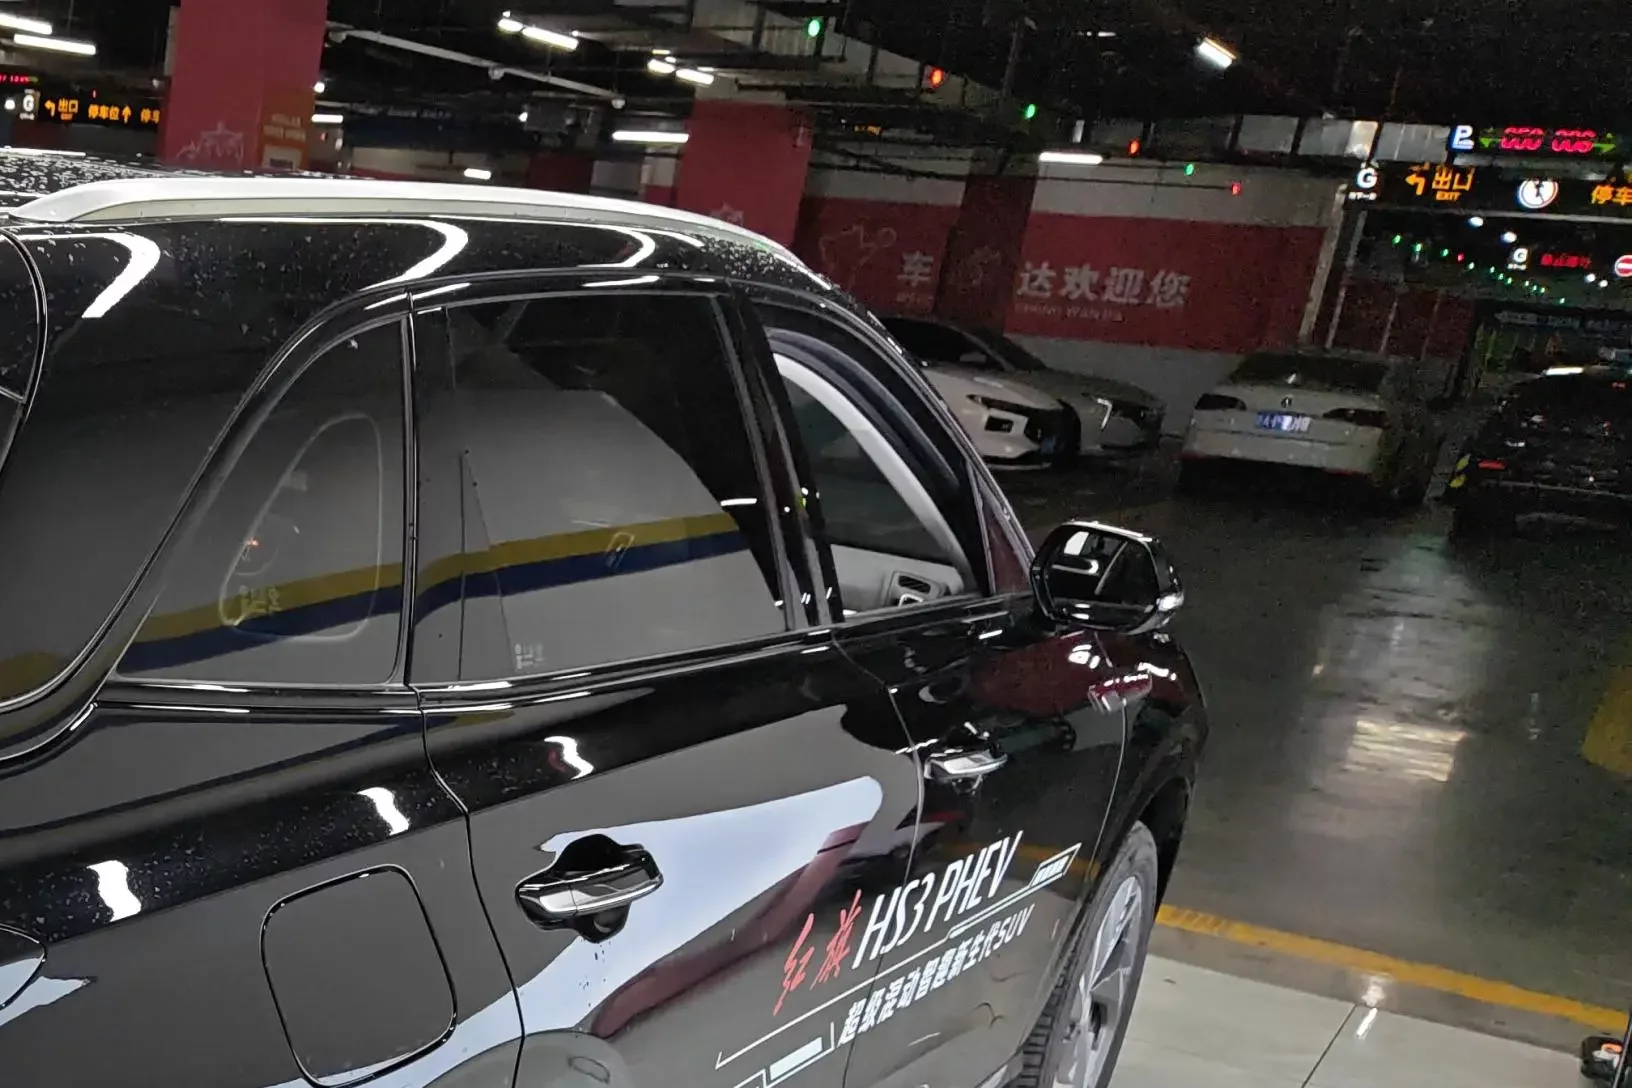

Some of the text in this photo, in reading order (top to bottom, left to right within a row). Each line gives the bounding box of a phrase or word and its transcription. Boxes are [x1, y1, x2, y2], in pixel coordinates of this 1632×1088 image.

[57, 98, 79, 114] 出口
[1356, 168, 1378, 189] G
[1431, 165, 1475, 191] 出口
[1435, 190, 1462, 201] EXIT
[1016, 261, 1191, 308] 达欢迎您
[851, 872, 936, 970] HS3
[923, 829, 1024, 933] PHEV
